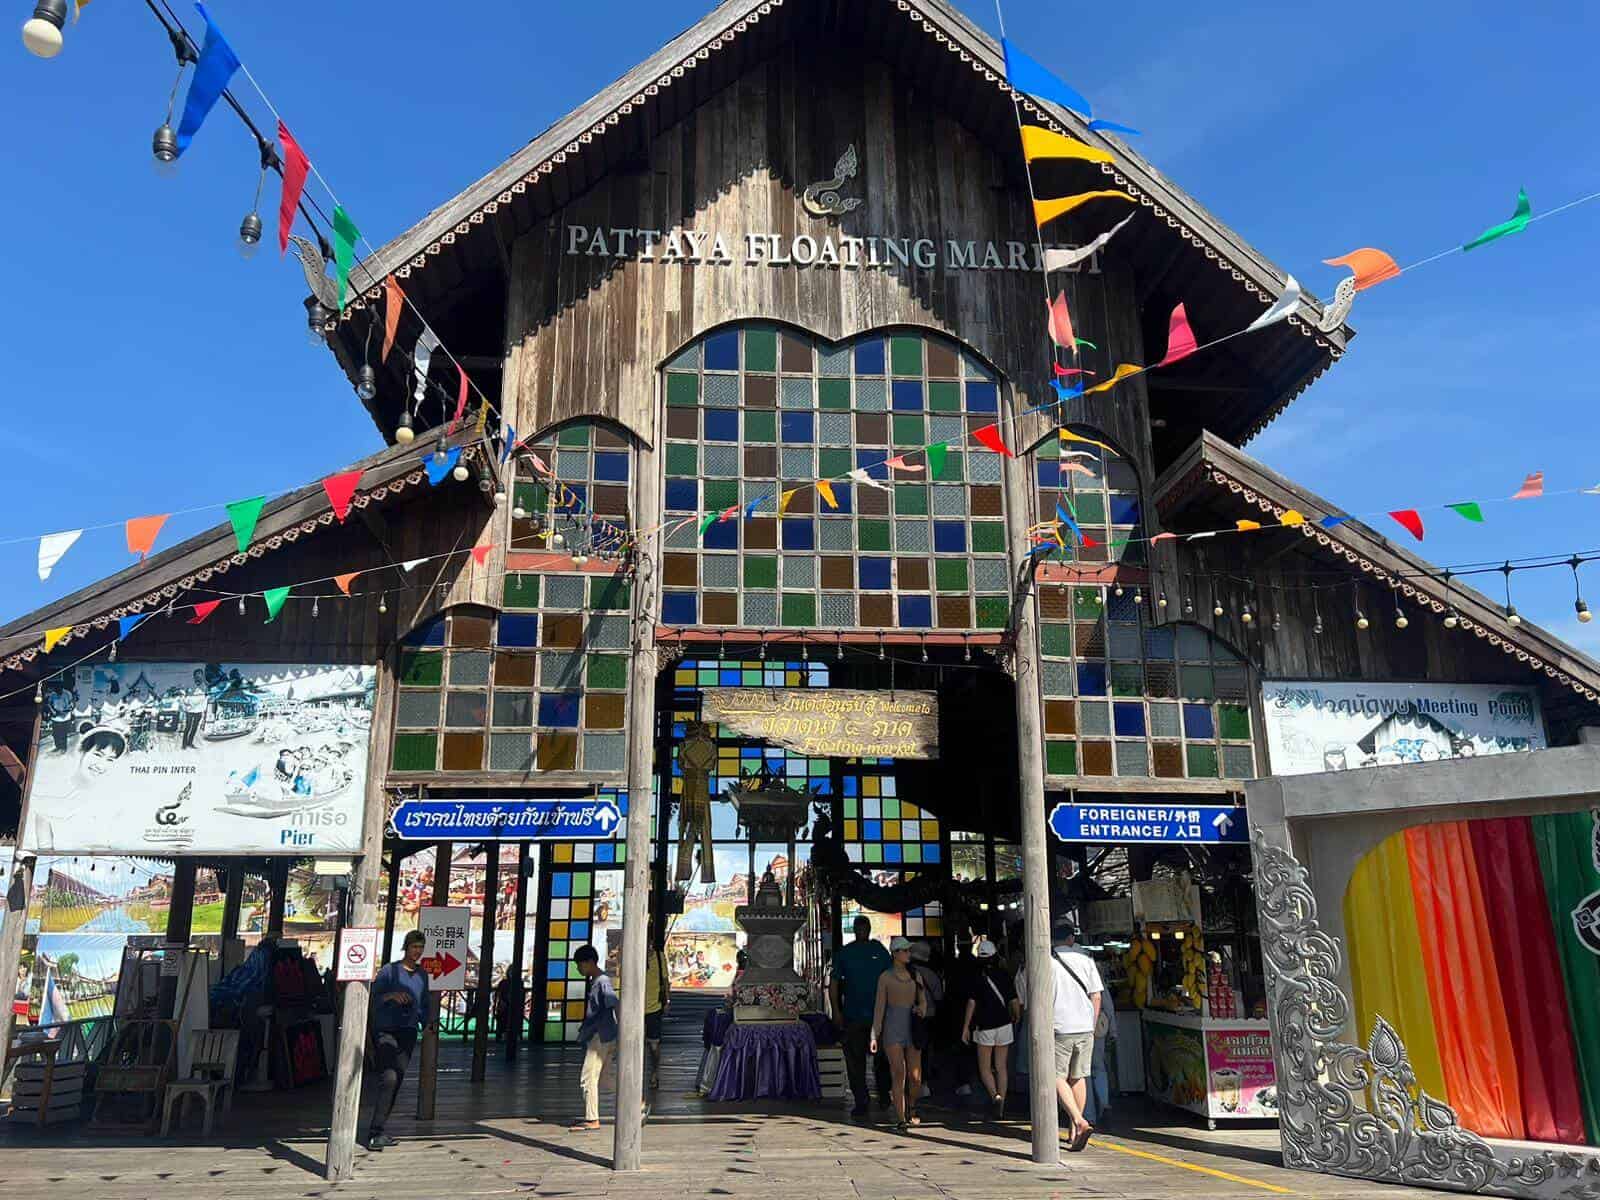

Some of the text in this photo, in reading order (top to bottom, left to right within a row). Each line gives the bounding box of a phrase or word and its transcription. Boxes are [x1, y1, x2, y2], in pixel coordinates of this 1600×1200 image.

[567, 225, 728, 260] PATTAYA
[746, 234, 936, 268] FLOATING
[1417, 698, 1479, 716] Meeting
[130, 766, 196, 774] THAI PIN INTER
[281, 829, 315, 846] Pier
[436, 939, 455, 948] PIER
